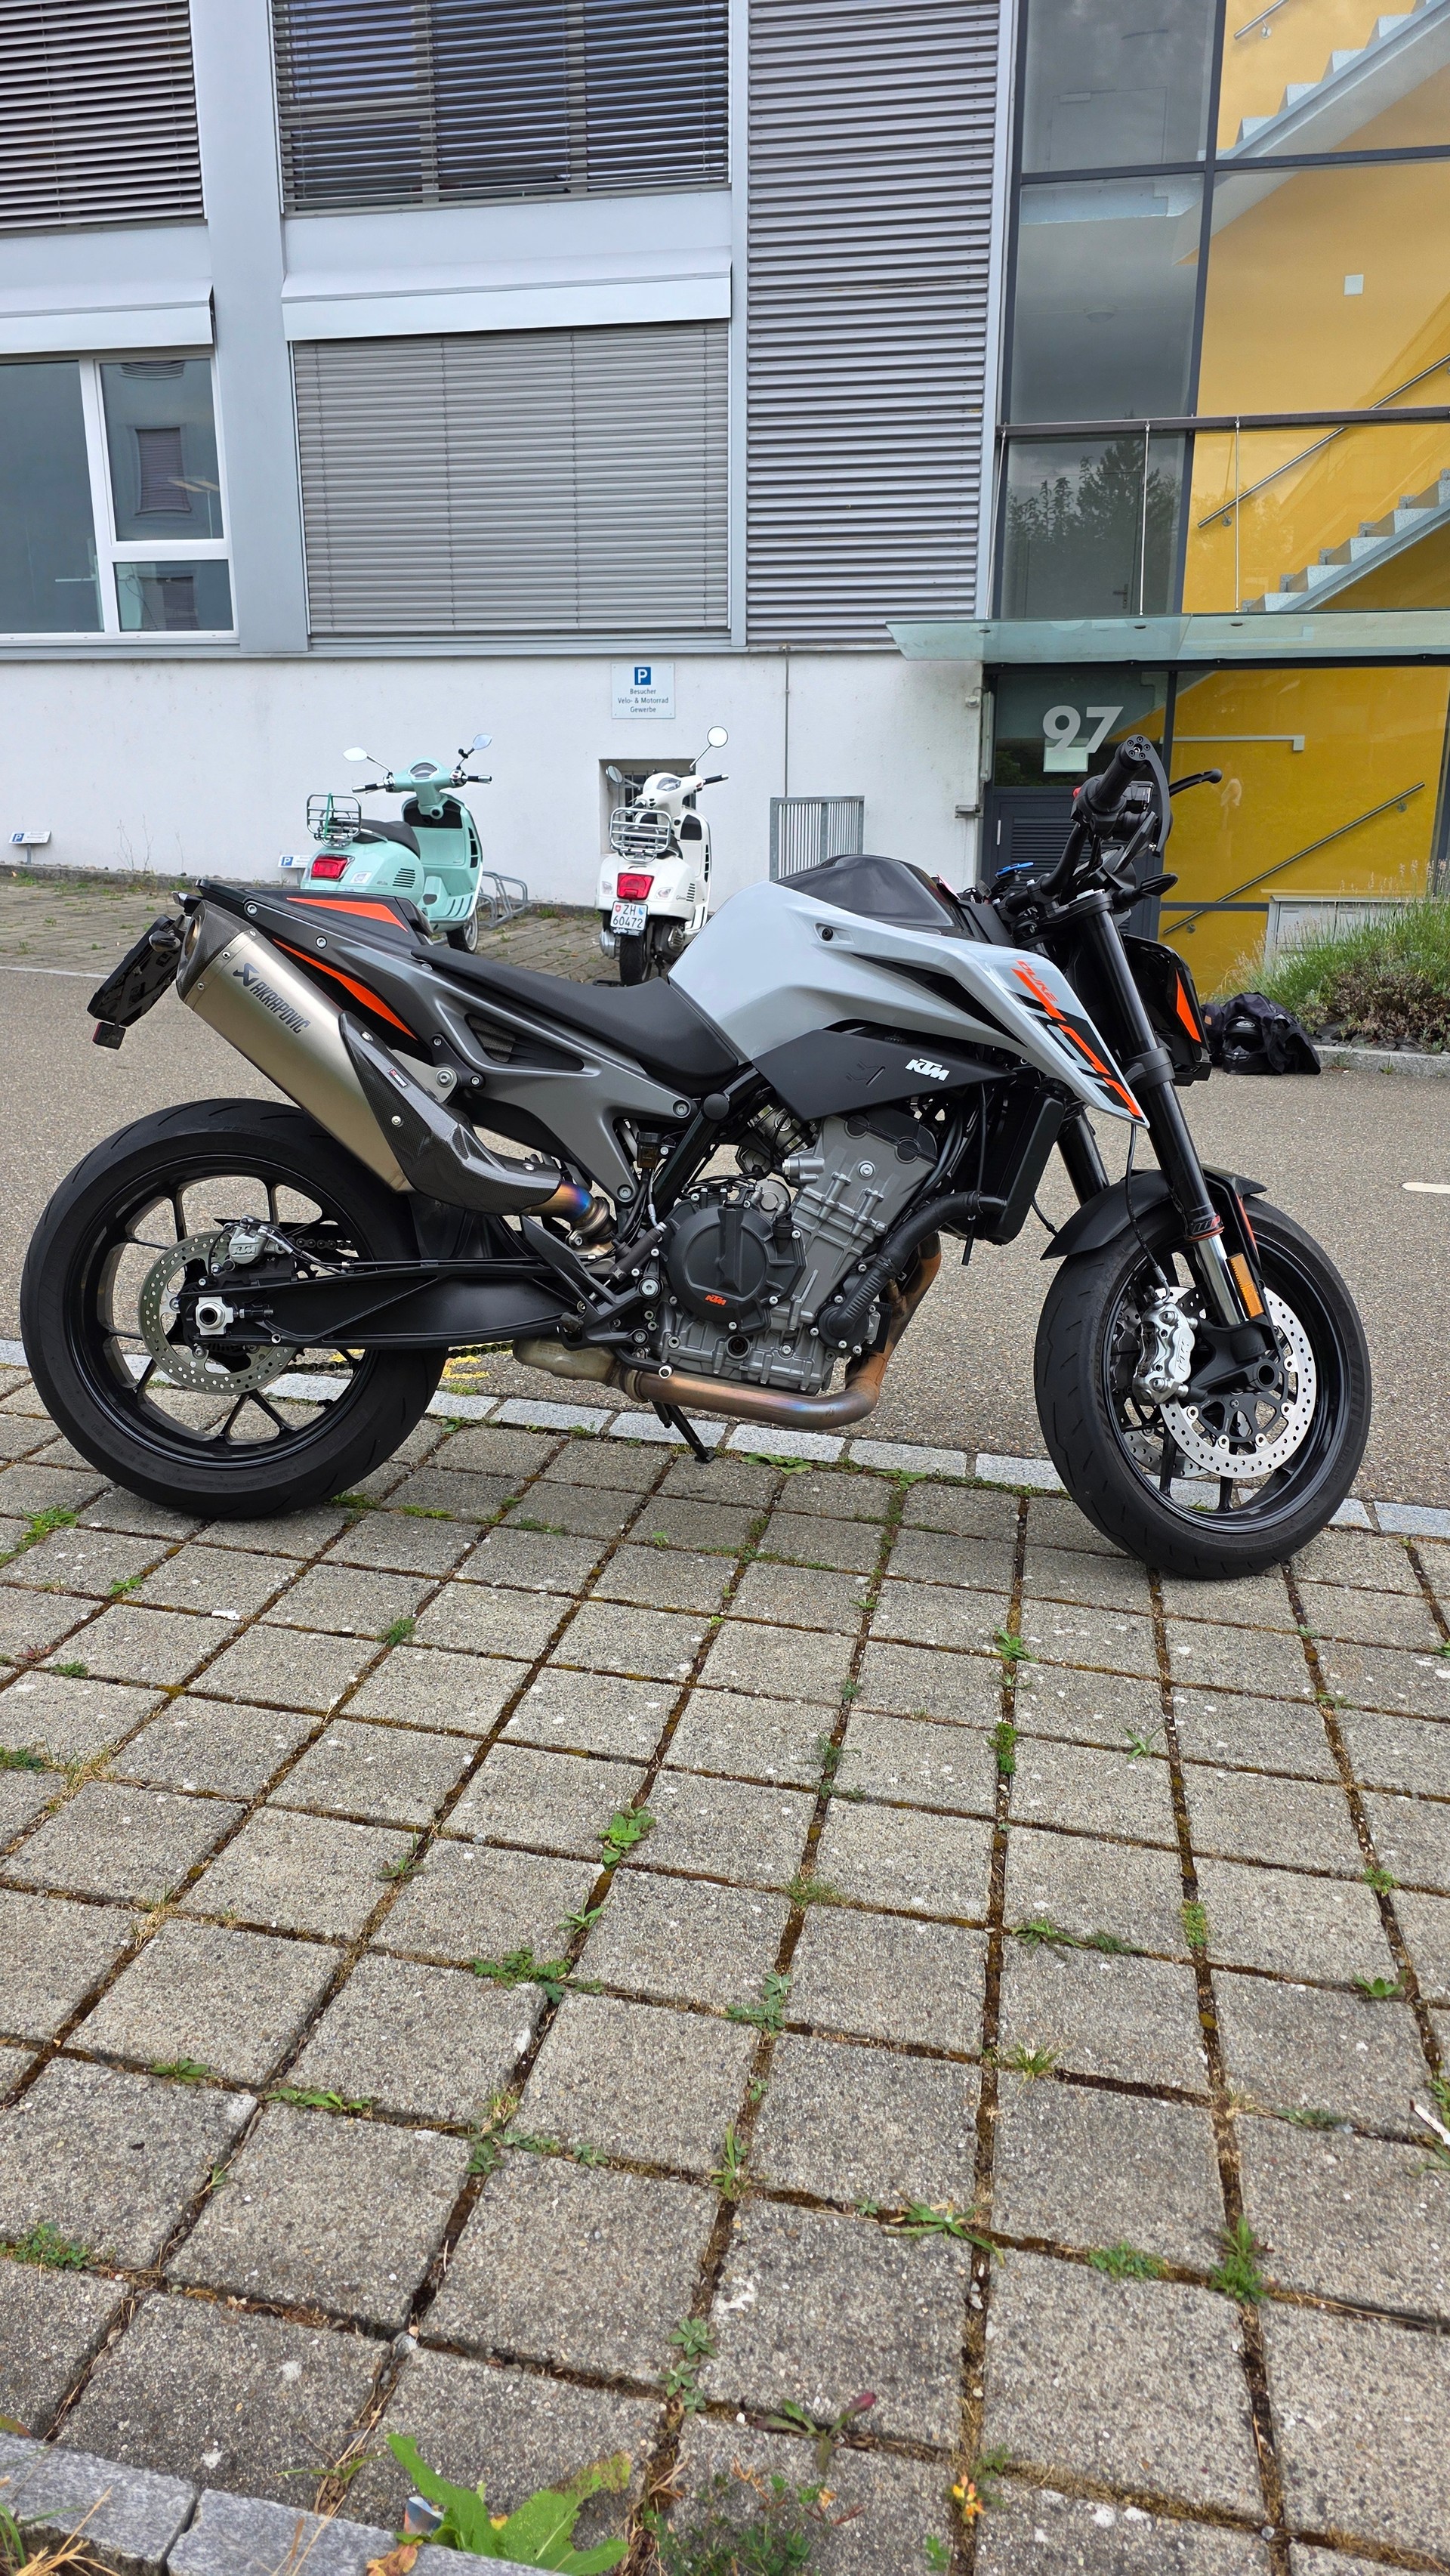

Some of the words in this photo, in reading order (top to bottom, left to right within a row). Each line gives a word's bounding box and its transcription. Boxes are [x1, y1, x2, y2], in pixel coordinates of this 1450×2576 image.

[637, 669, 648, 684] P
[1042, 705, 1124, 754] 97
[622, 904, 636, 916] ZH
[612, 915, 643, 928] 60472
[1016, 959, 1059, 1002] DUKE
[905, 1058, 950, 1082] KTM
[231, 1245, 257, 1255] KTM
[705, 1294, 727, 1305] KTM
